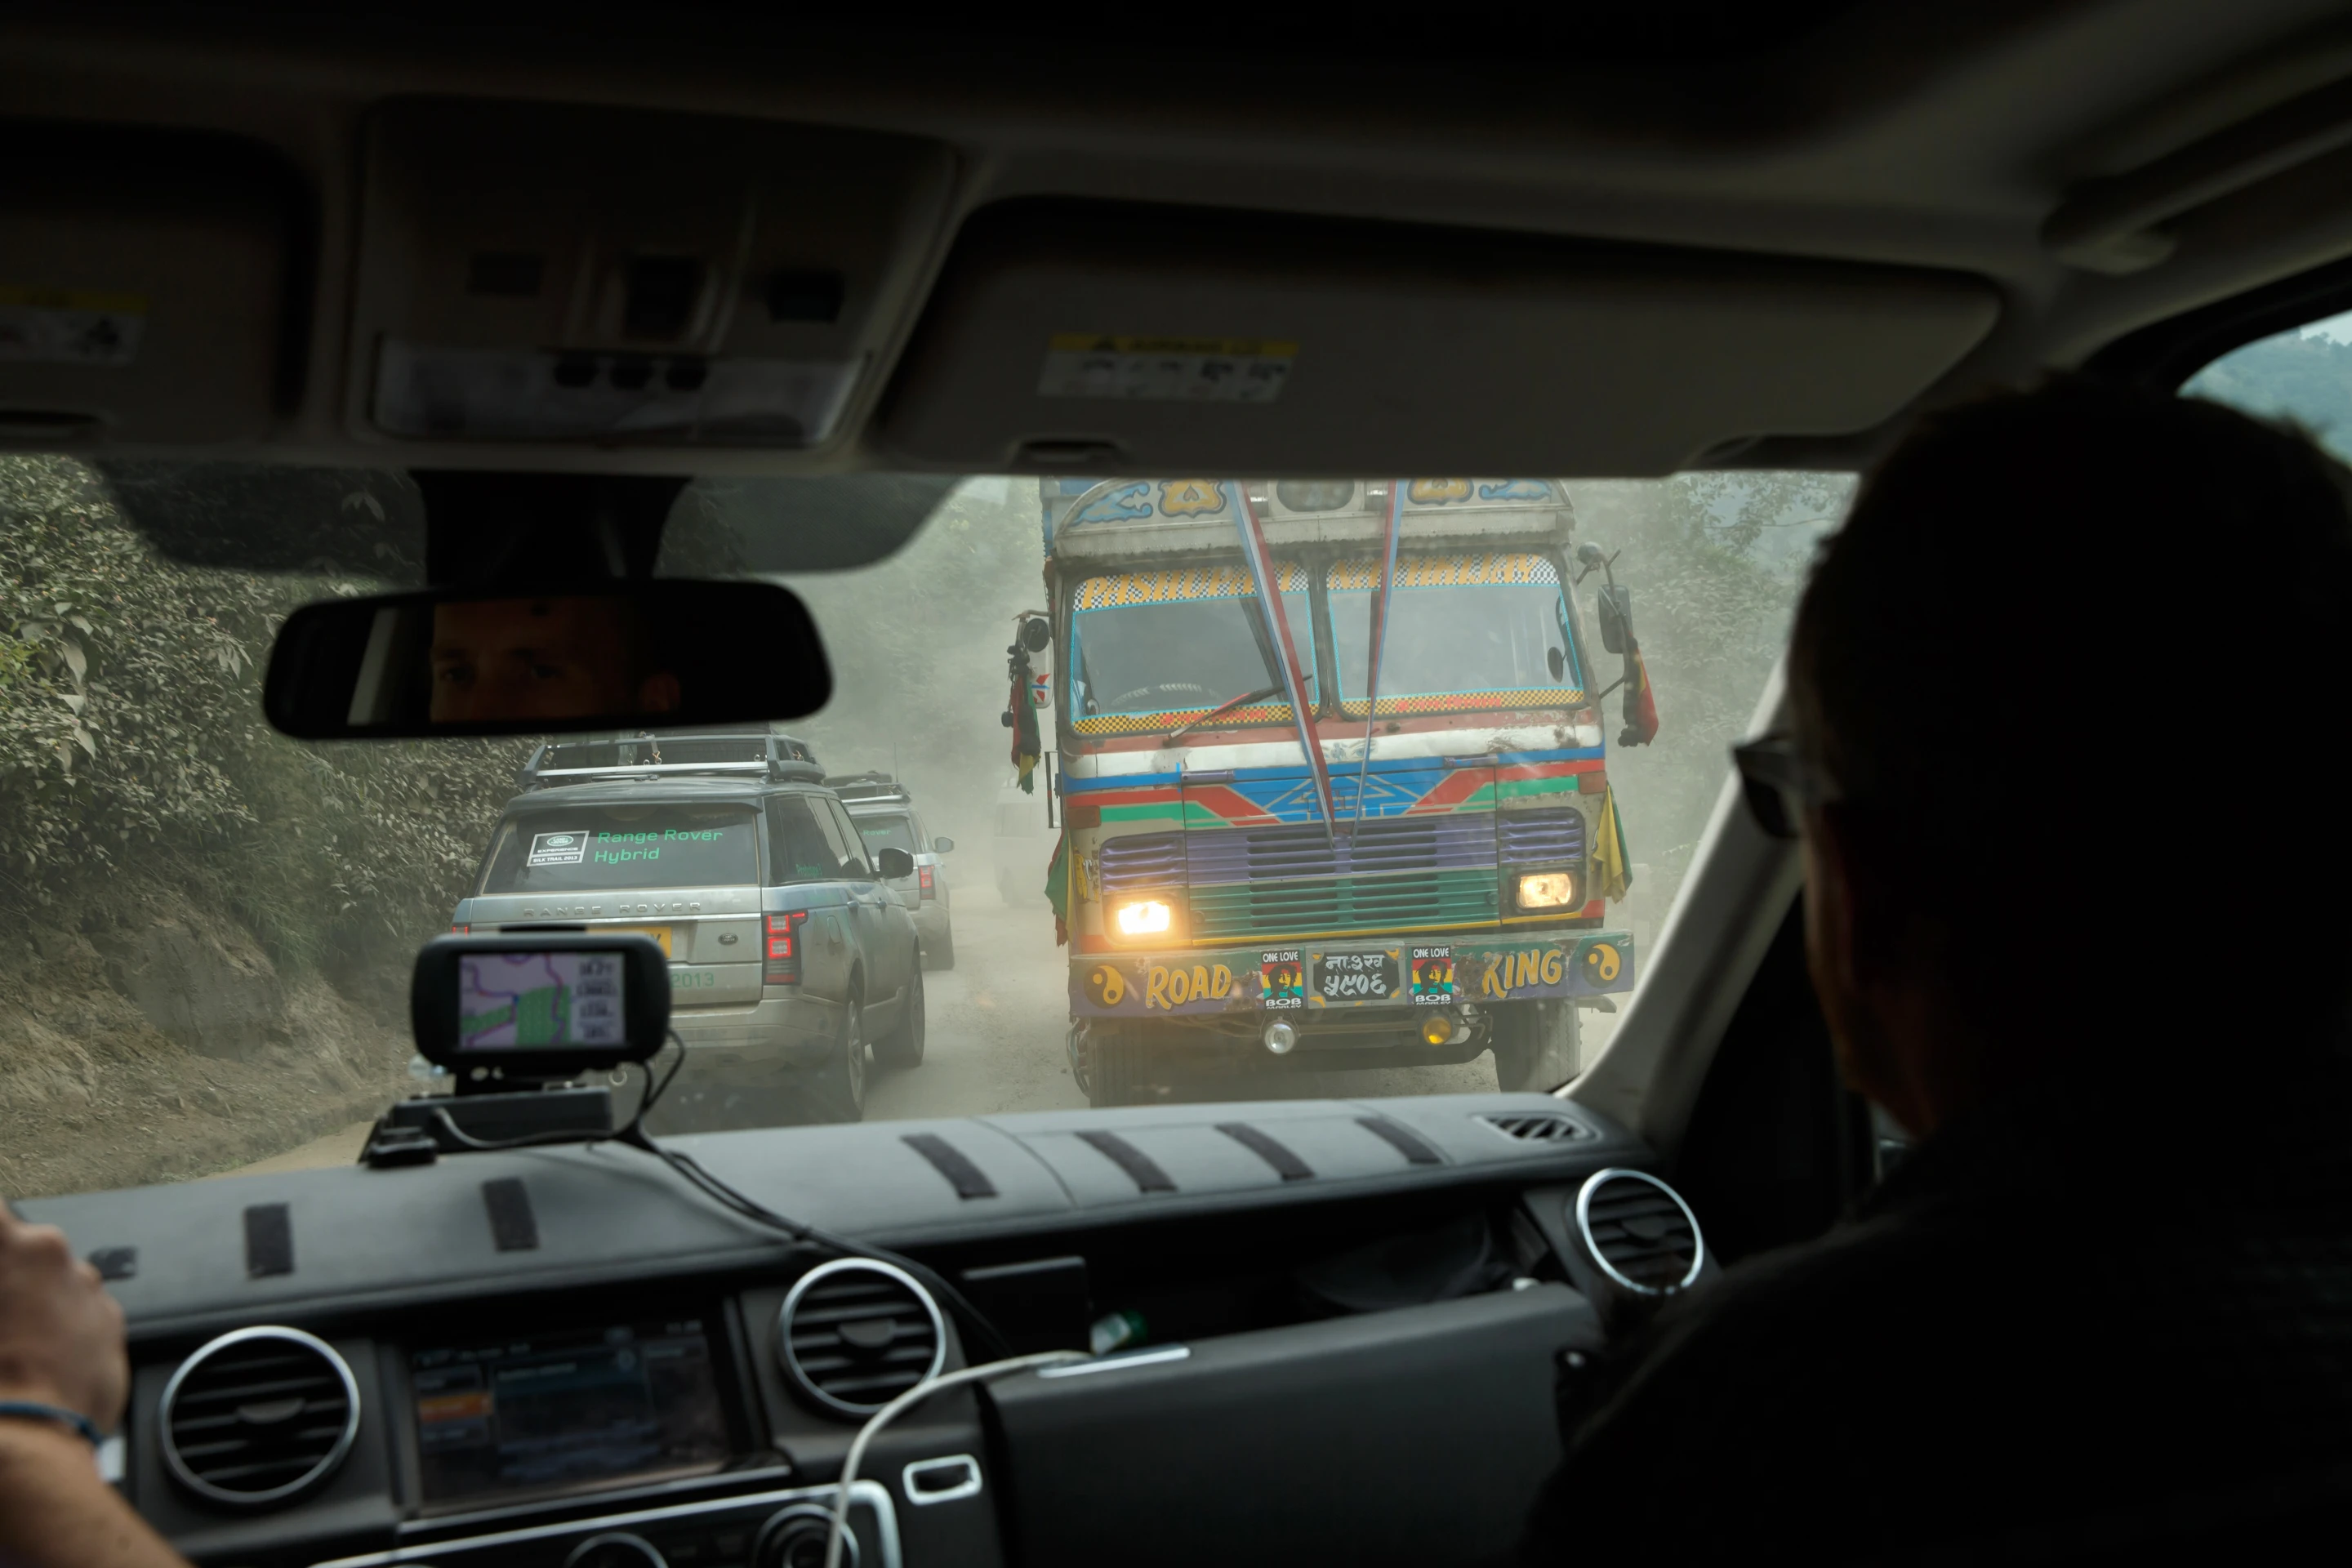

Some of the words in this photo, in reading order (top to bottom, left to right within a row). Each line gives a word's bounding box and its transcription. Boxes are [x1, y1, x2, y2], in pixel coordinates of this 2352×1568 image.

[1081, 564, 1297, 609] PASHUPAI
[597, 832, 658, 844] Range
[664, 829, 723, 841] Rover
[595, 847, 660, 864] Hybrid
[523, 906, 602, 917] RANGE
[619, 902, 701, 913] ROVER
[1263, 952, 1278, 962] ONE
[1280, 951, 1298, 961] LOVE
[1413, 948, 1429, 958] ONE
[1431, 947, 1450, 957] LOVE
[671, 972, 715, 988] 2013
[1481, 949, 1562, 999] KING
[1145, 964, 1232, 1010] ROAD
[1265, 997, 1302, 1006] BOB
[1415, 994, 1451, 1002] BOB
